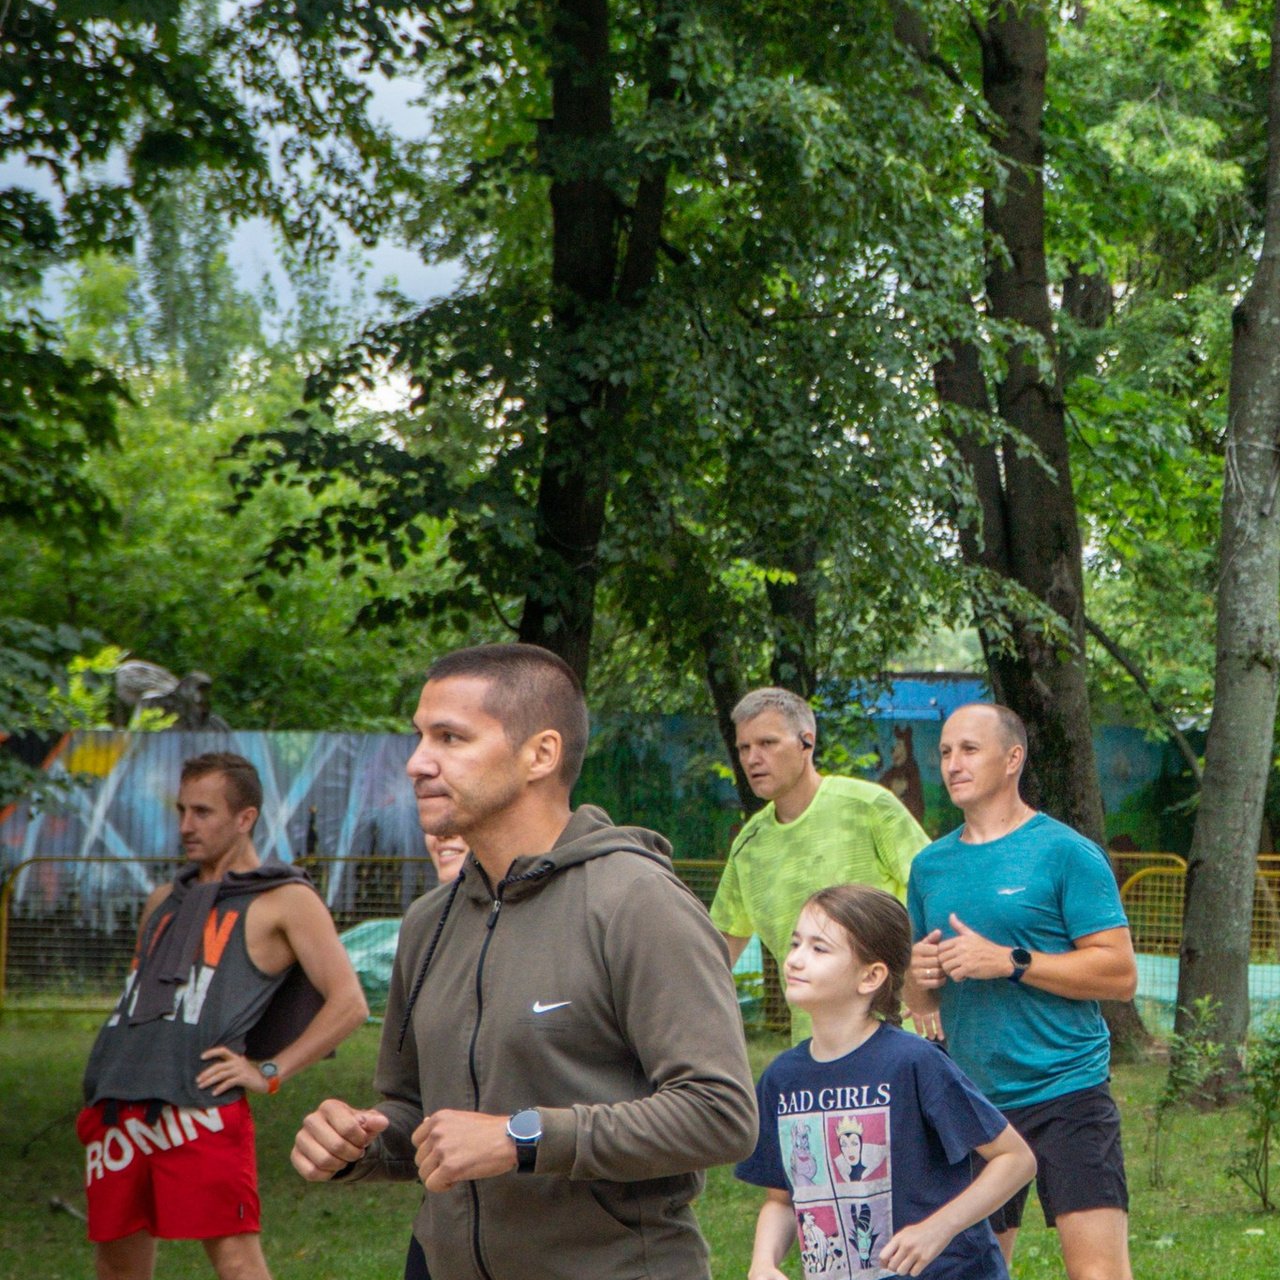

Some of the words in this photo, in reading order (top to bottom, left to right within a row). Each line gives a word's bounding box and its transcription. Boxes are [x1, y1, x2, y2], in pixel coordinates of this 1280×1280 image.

[777, 1090, 814, 1115] BAD
[818, 1083, 891, 1111] GIRLS
[85, 1104, 225, 1188] RONIN
